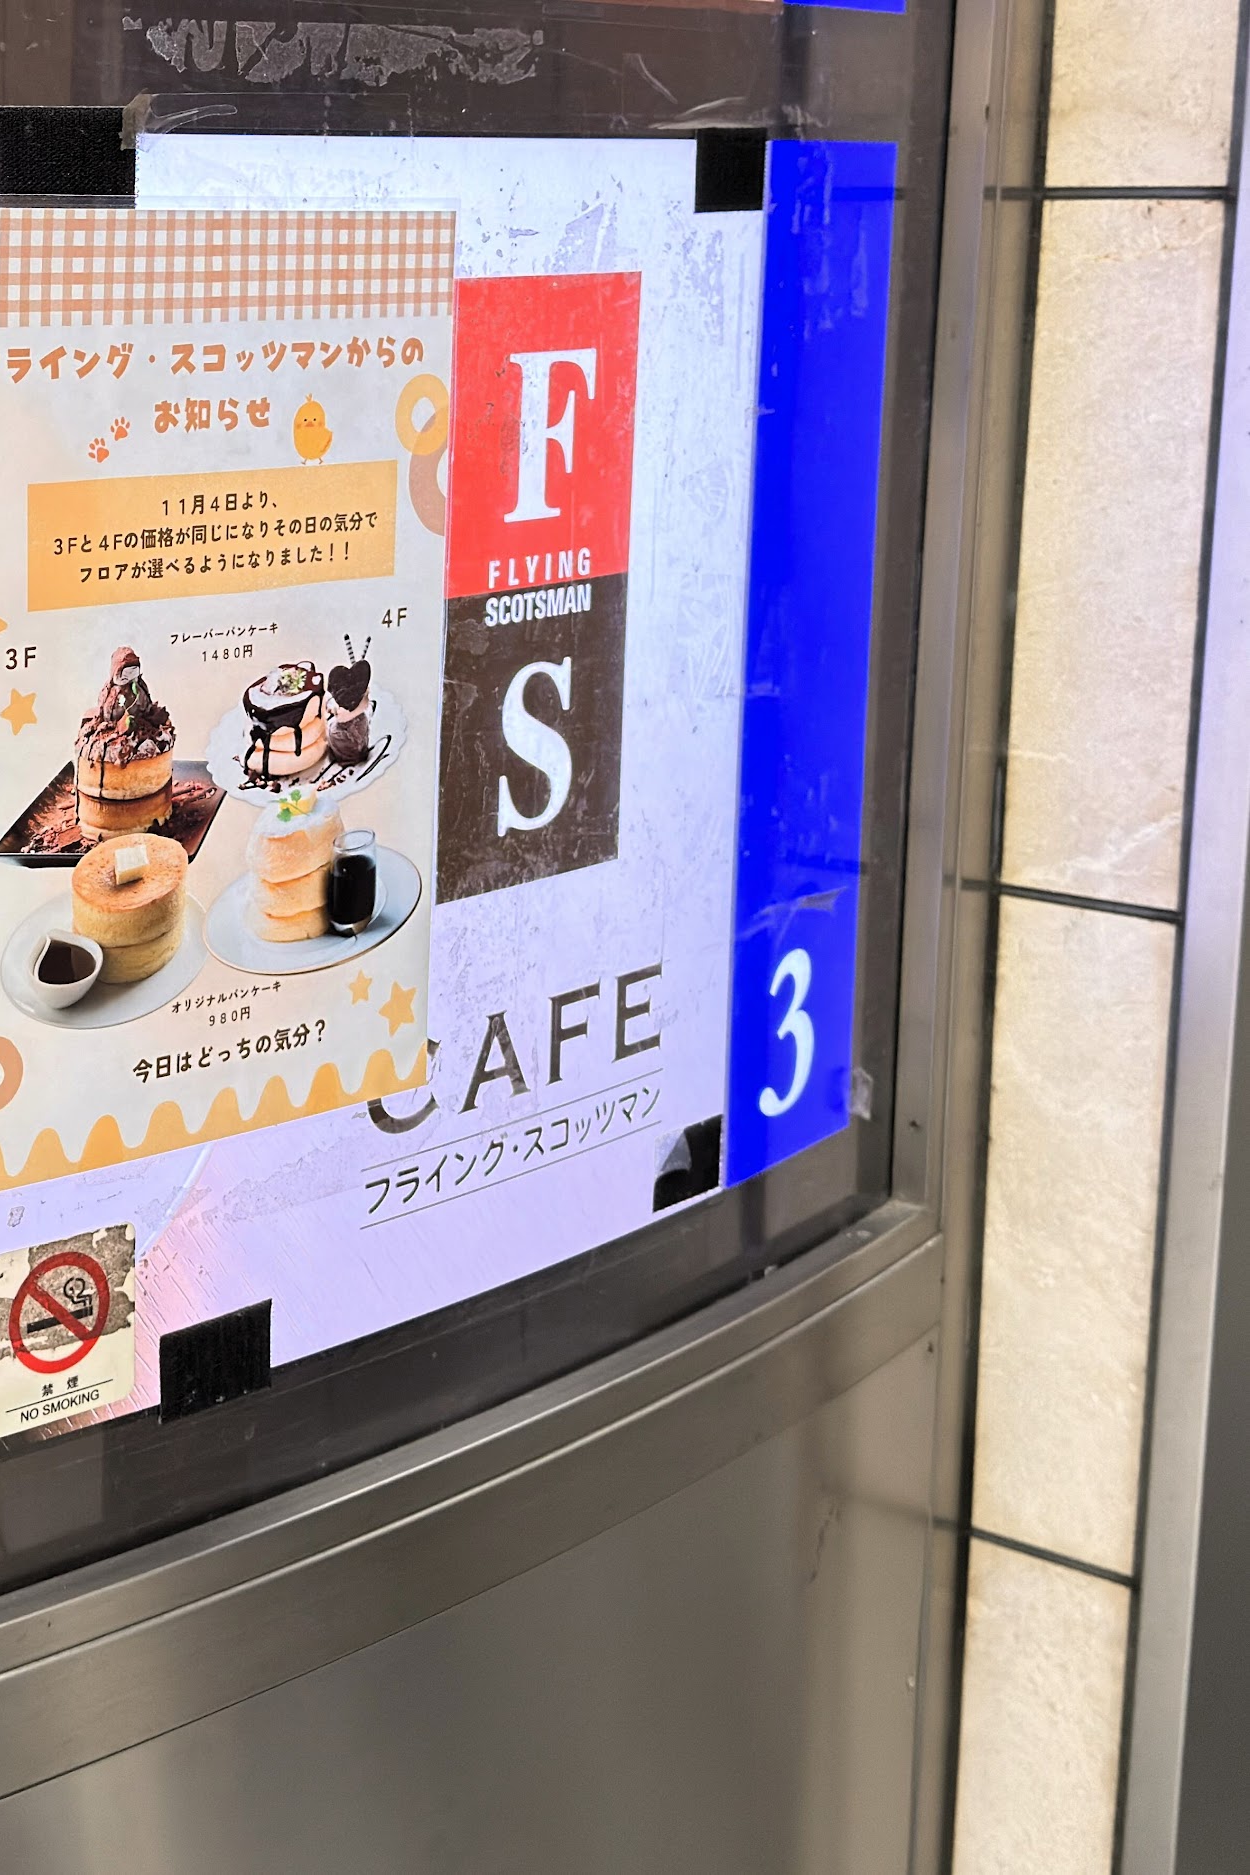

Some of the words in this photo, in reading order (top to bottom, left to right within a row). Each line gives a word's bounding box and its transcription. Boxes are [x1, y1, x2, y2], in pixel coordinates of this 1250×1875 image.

[154, 397, 270, 434] お知らせ
[504, 348, 597, 523] F
[488, 547, 591, 590] FLYING
[382, 608, 408, 628] 4F
[485, 585, 591, 627] SCOTSMAN
[6, 647, 36, 669] 3F
[202, 645, 253, 662] 1480円
[498, 656, 572, 837] S
[172, 981, 281, 1013] オリジナルパンケーキ
[209, 1006, 251, 1026] 980円
[759, 948, 814, 1118] 3
[133, 1019, 326, 1083] 今日はどっちの気分？
[366, 1087, 661, 1214] フライング・スコッツマン
[42, 1376, 79, 1397] 禁煙
[20, 1409, 39, 1423] NO
[43, 1390, 100, 1416] SMOKING
